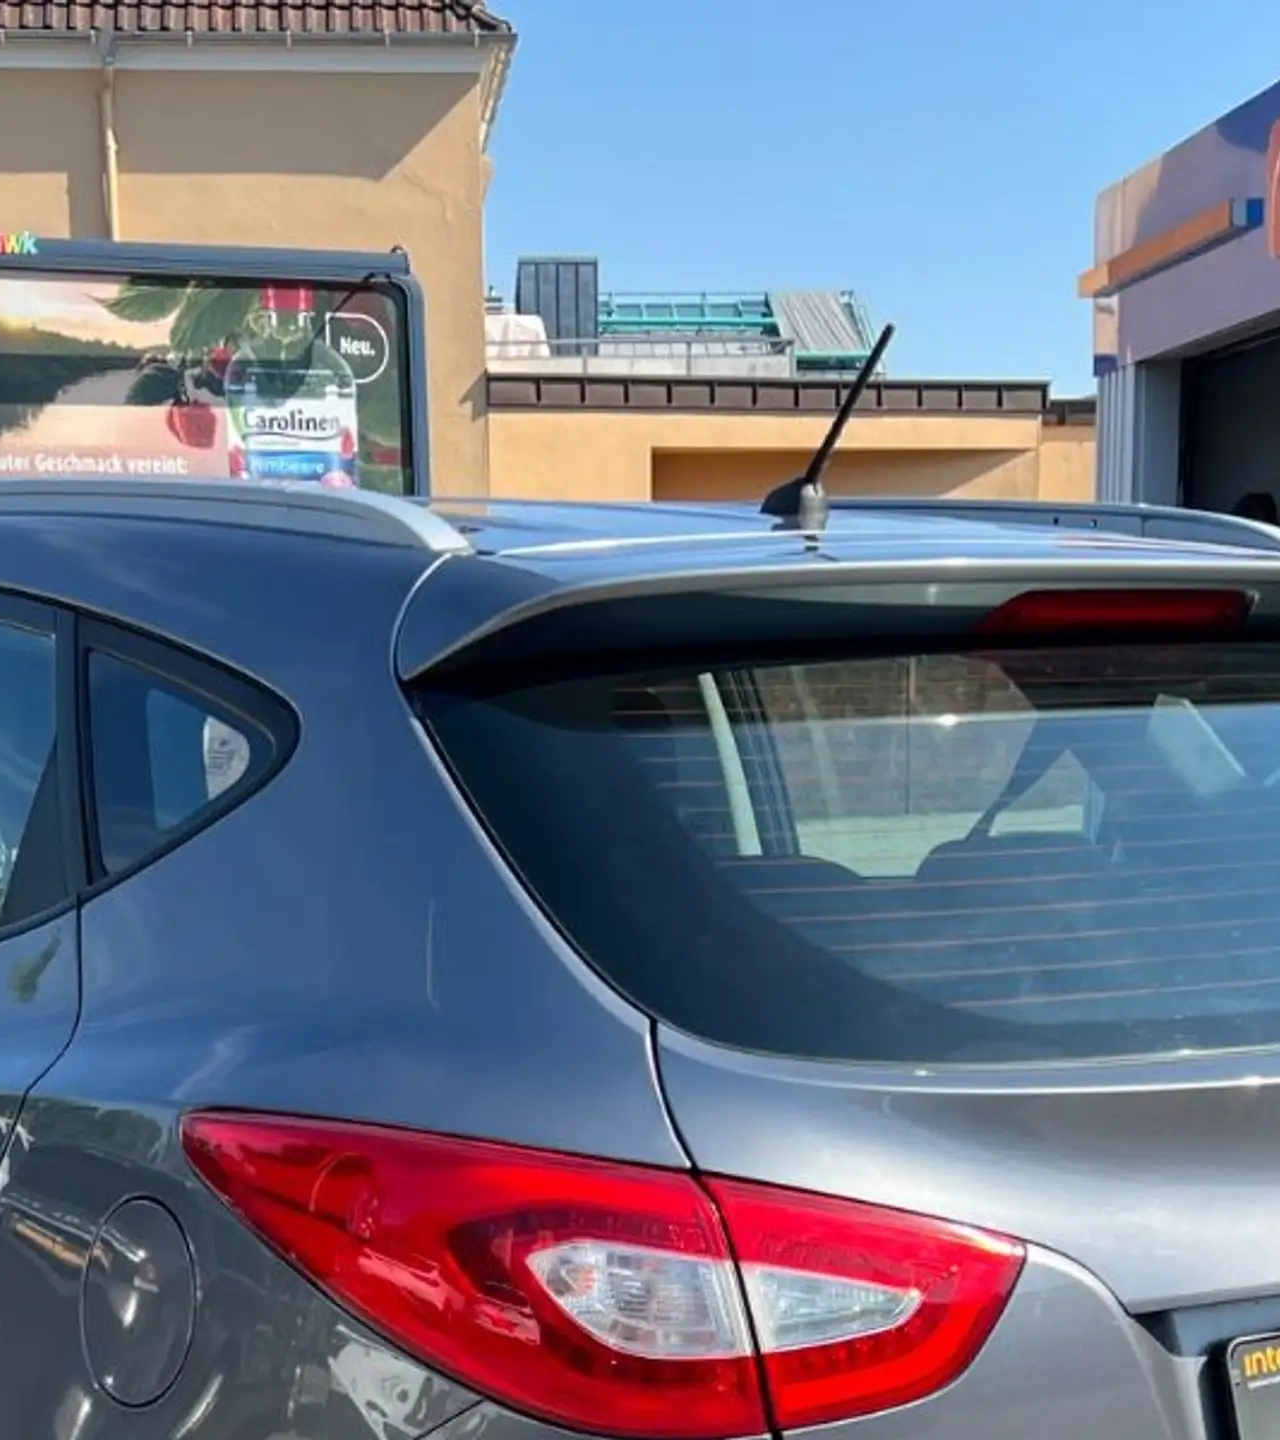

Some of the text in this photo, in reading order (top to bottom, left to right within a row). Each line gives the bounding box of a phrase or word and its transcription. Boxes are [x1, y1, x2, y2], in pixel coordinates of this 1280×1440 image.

[339, 335, 376, 357] Neu.
[244, 408, 341, 432] Carolinen
[34, 452, 123, 474] Geschmack
